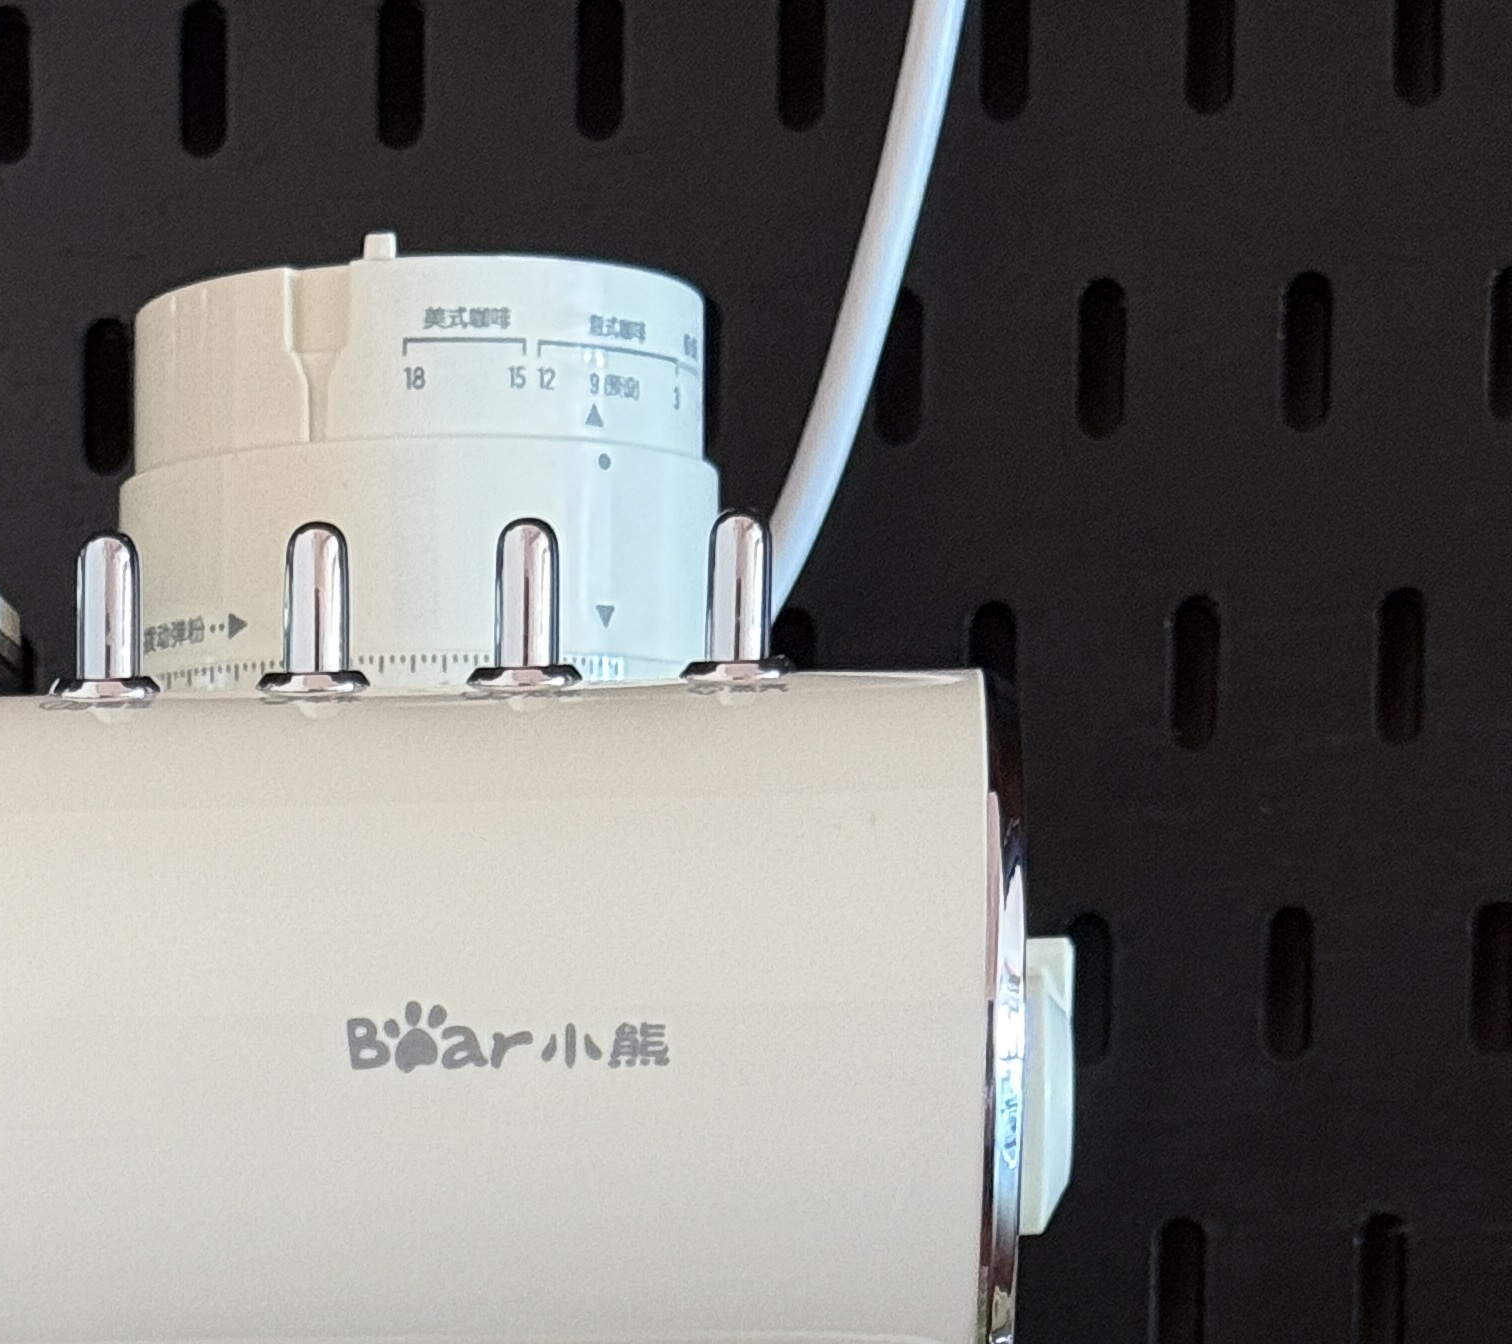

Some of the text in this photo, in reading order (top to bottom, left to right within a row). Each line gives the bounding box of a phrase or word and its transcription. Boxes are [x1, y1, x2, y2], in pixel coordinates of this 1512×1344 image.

[403, 366, 426, 390] 18
[508, 366, 526, 389] 15
[537, 367, 556, 391] 12
[589, 372, 600, 395] 9
